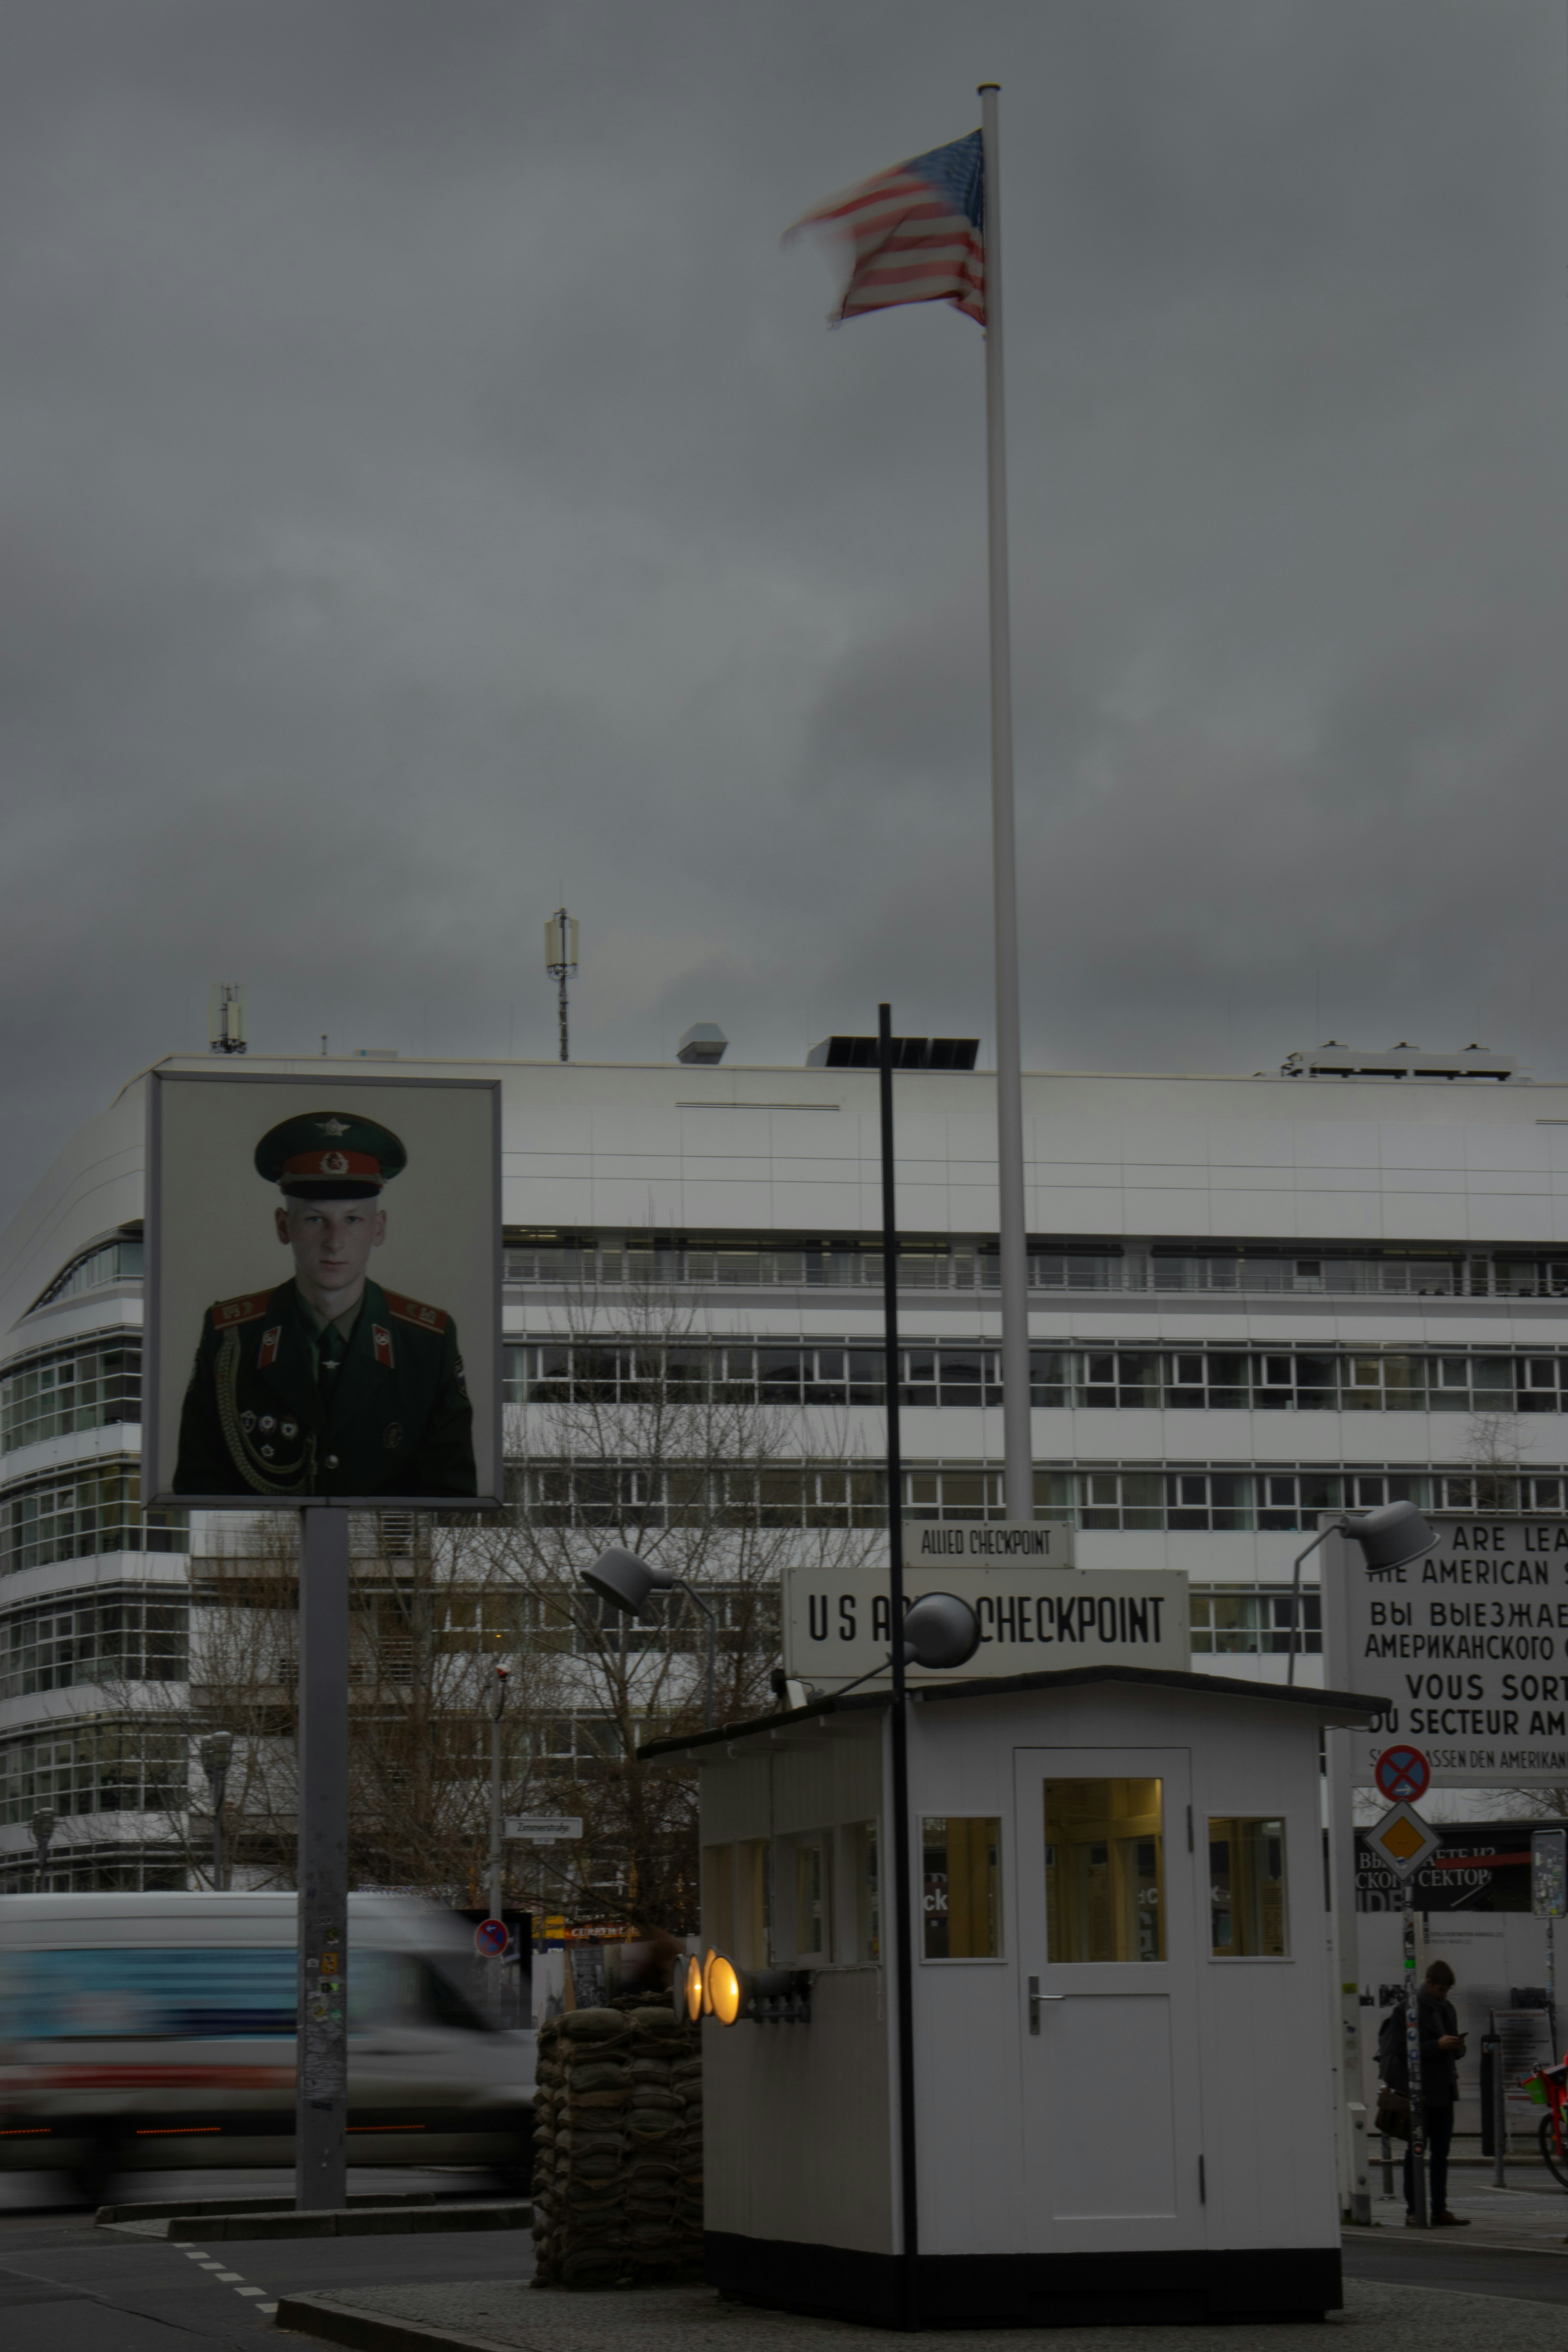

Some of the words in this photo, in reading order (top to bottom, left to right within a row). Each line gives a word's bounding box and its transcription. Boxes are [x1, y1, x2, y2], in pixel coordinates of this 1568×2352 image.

[922, 1530, 964, 1554] ALLIED
[970, 1530, 1050, 1555] CHECKPOINT
[1453, 1526, 1506, 1551] ARE
[1422, 1559, 1548, 1585] AMERICAN
[977, 1596, 1164, 1643] CHECKPOINT
[1371, 1601, 1412, 1626] ВЫ
[1431, 1602, 1568, 1628] ВЫЕЗЖАЕ
[1365, 1634, 1554, 1660] АМЕРИКАНСКОГО
[1406, 1674, 1483, 1700] VOUS
[1410, 1708, 1519, 1735] SECTEUR
[1470, 1750, 1494, 1768] DEN
